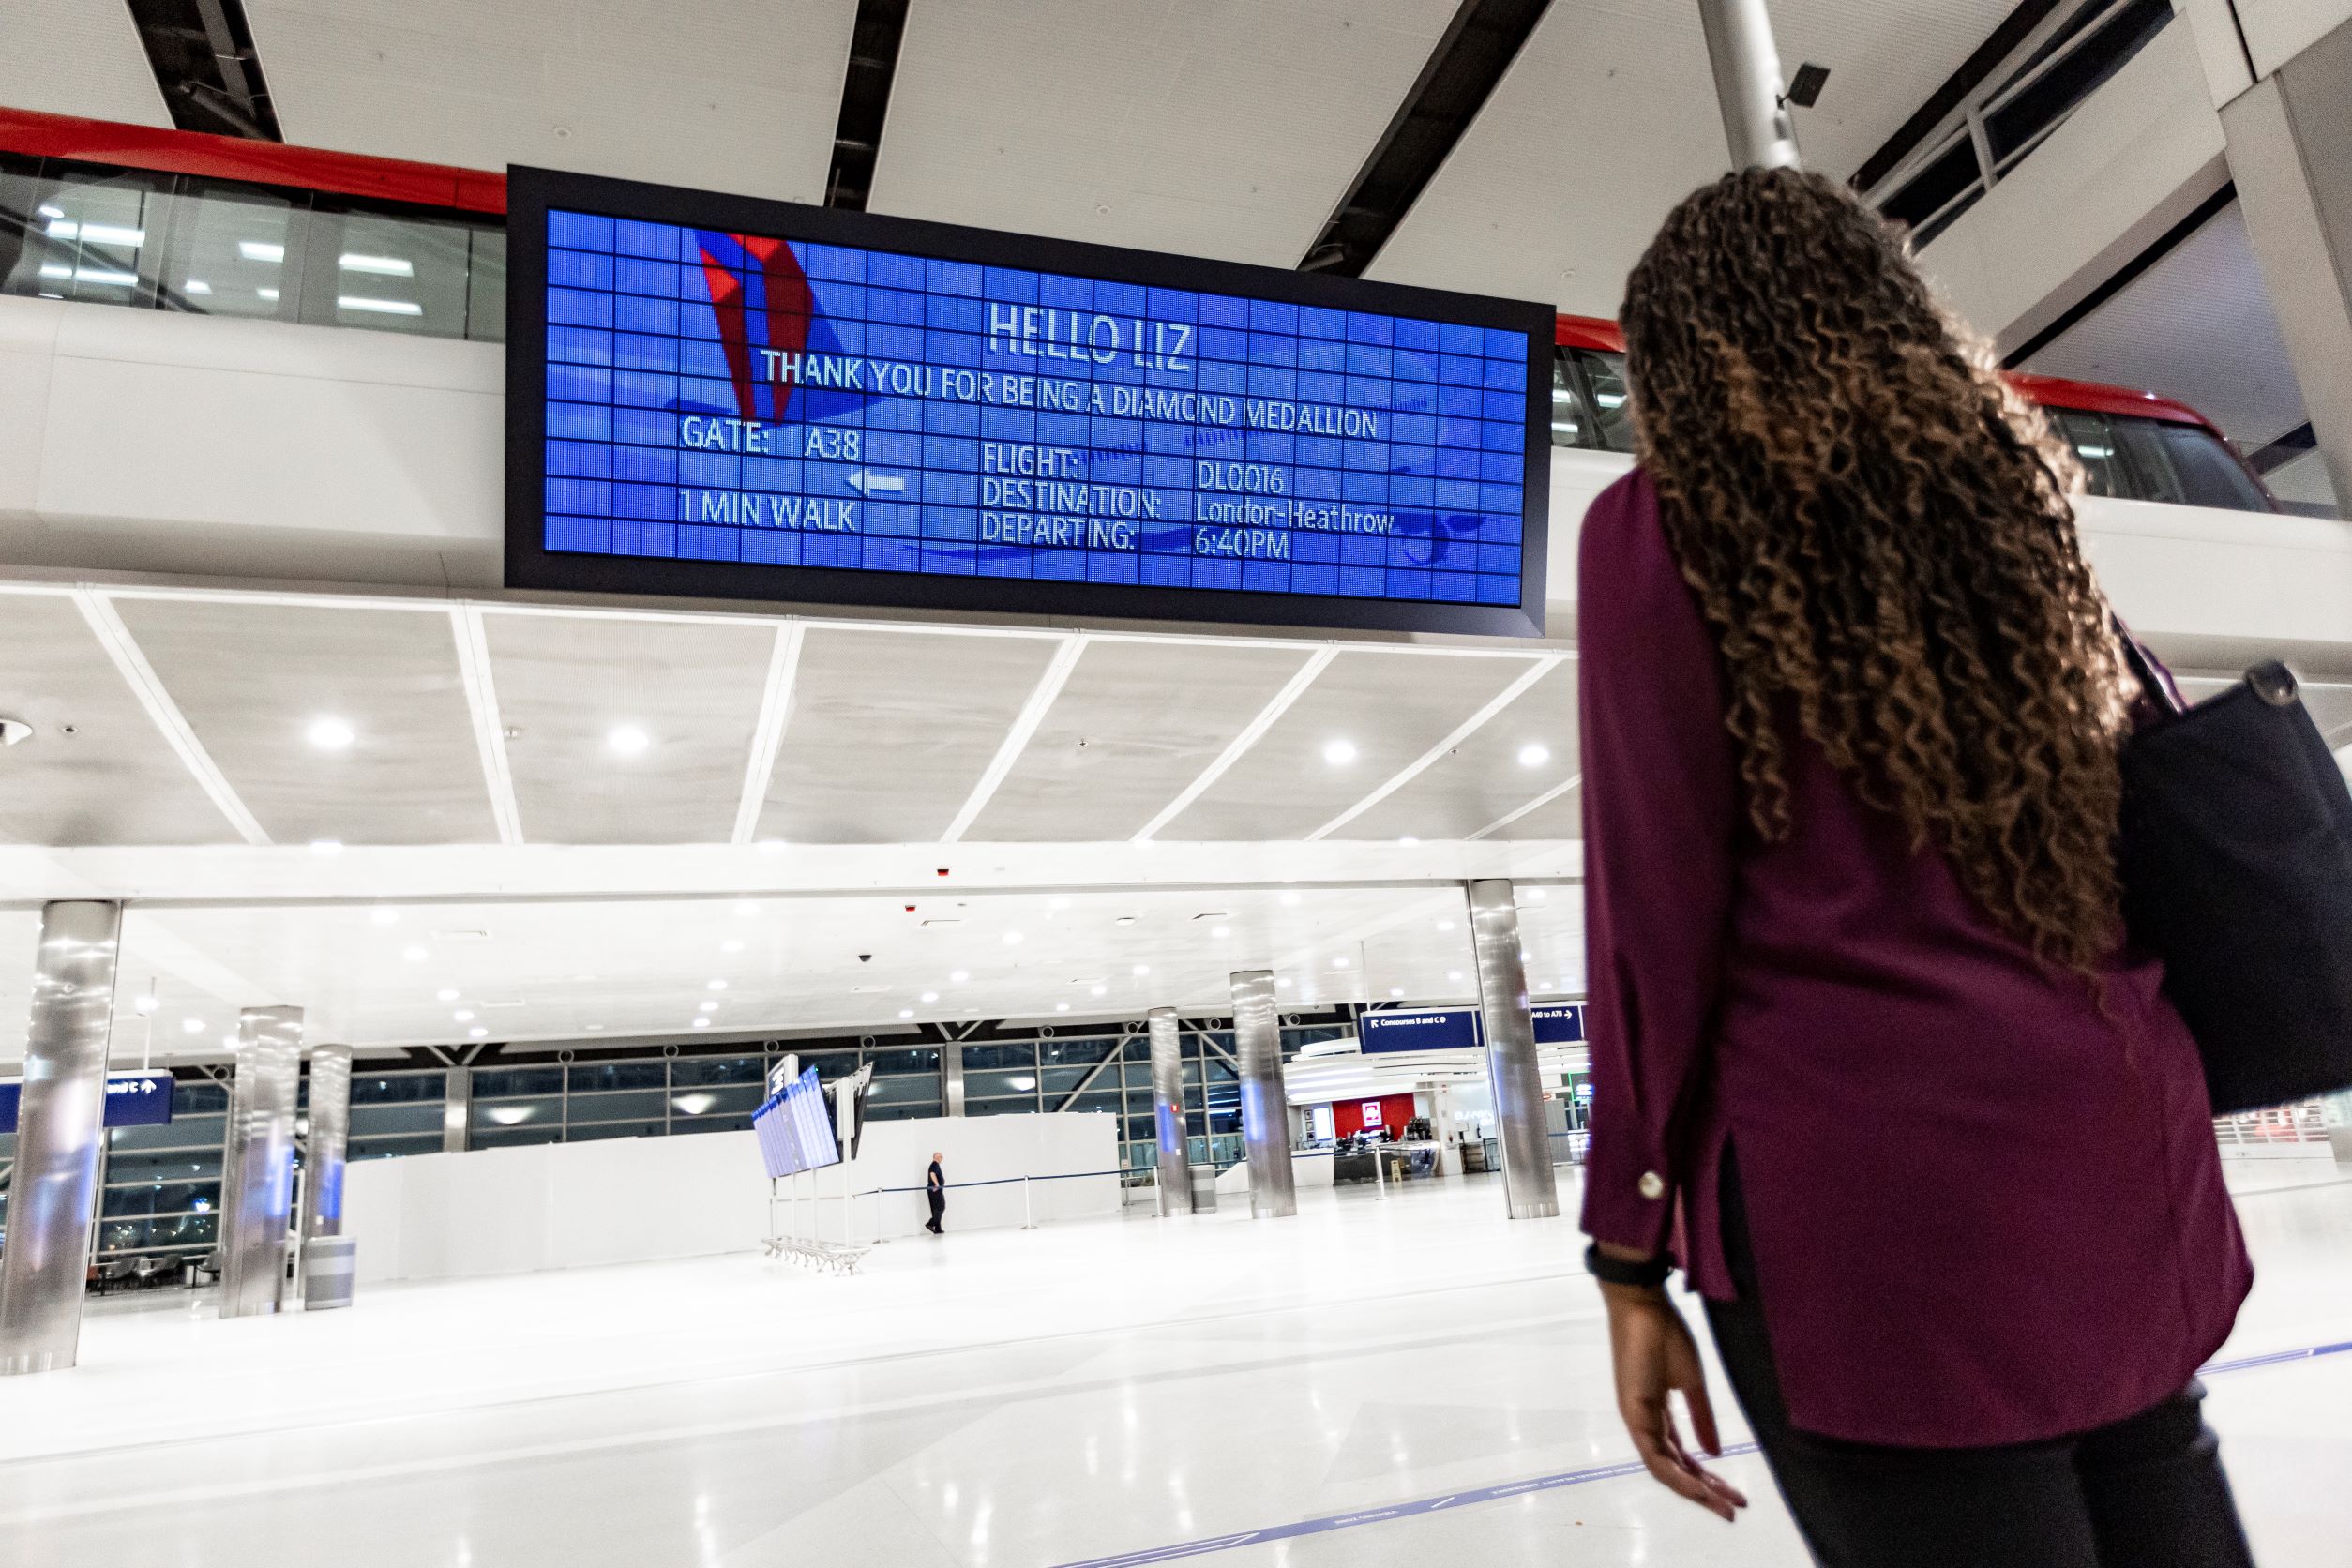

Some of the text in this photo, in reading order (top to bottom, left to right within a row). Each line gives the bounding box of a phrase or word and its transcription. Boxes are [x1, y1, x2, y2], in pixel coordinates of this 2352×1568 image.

[989, 302, 1192, 372] HELLO LIZ
[761, 350, 1377, 438] THANK YOU FOR BEING A DIAMOND MEDALLION
[682, 416, 860, 461] GATE: A38
[983, 443, 1078, 478] FLIGHT:
[679, 490, 855, 532] 1 MIN WALK
[982, 477, 1395, 533] DESTINATION: London-Heathrow
[981, 511, 1289, 558] DEPARTING: 6:40PM
[1380, 1018, 1416, 1027] Concourses
[1422, 1016, 1434, 1025] and
